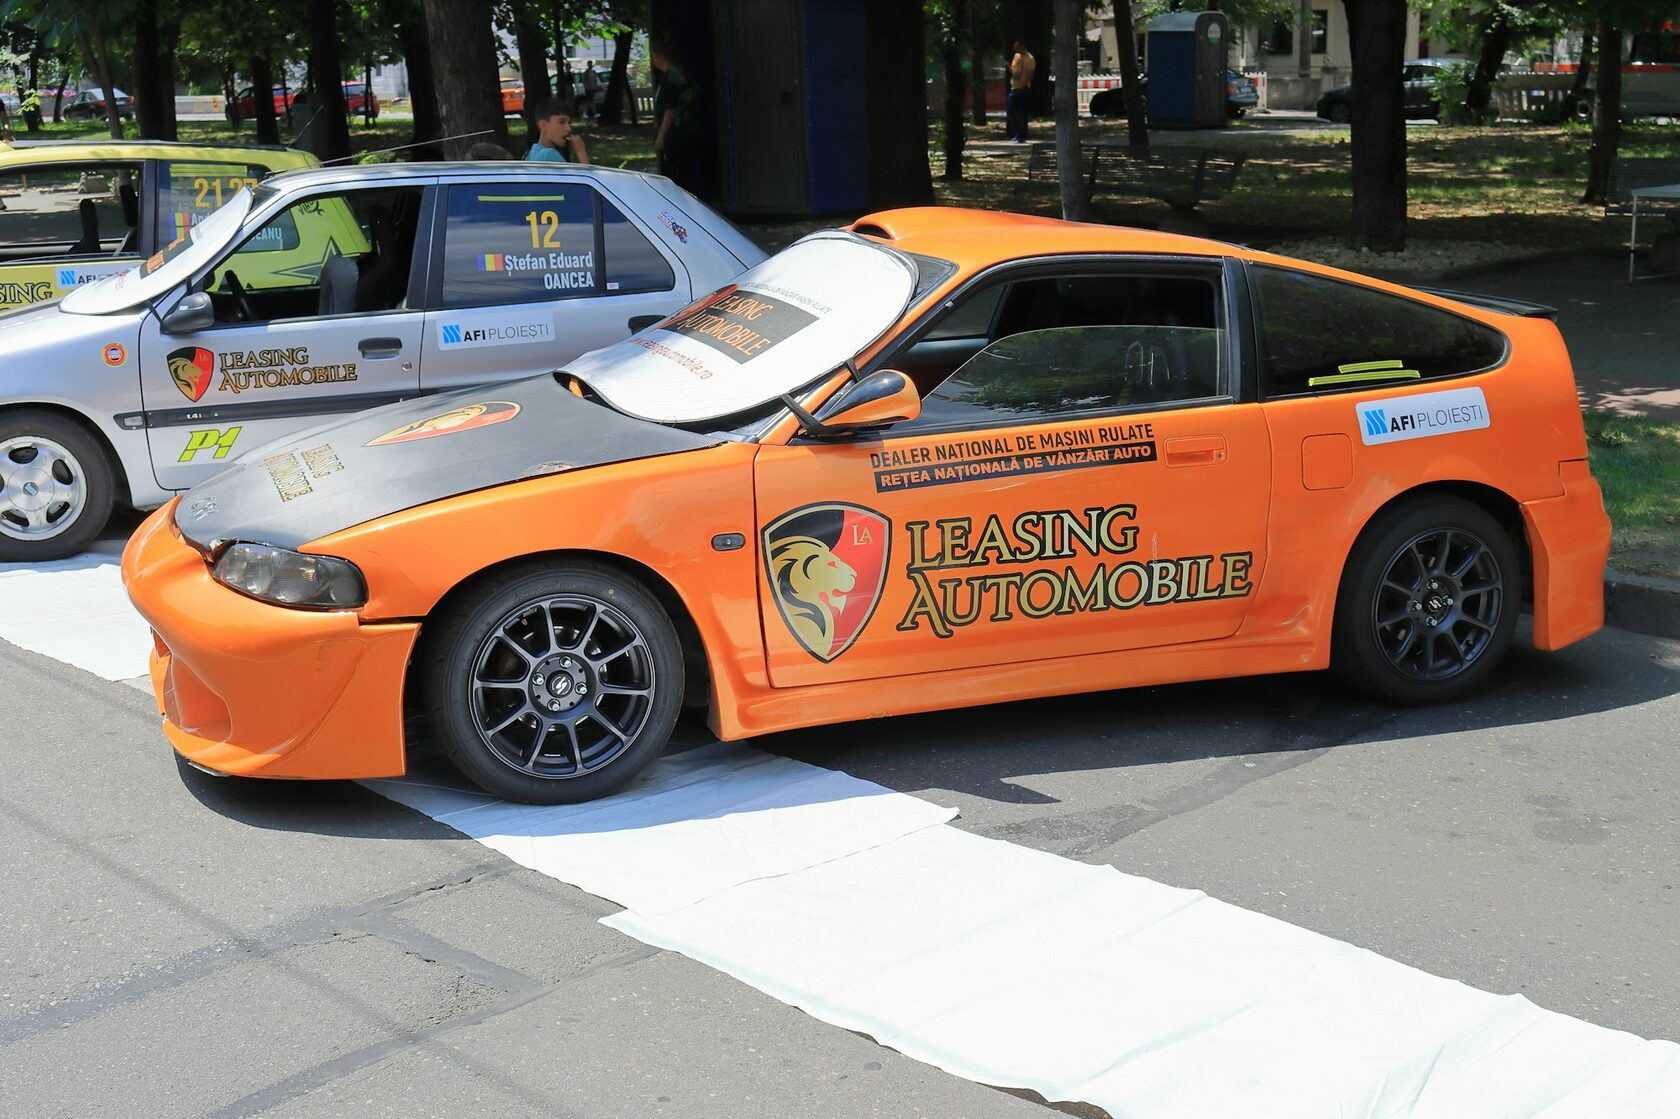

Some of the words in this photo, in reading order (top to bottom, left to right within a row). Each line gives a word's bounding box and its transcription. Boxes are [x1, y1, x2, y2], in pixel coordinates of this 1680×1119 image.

[525, 210, 561, 249] 12
[504, 254, 547, 277] Ștefan
[549, 251, 593, 270] Eduard
[544, 271, 594, 290] OANCEA
[710, 294, 774, 321] LEASING
[463, 329, 486, 342] AFI
[488, 323, 549, 339] PLOIEȘTI
[676, 308, 772, 356] AUTOMOBILE
[218, 347, 309, 370] LEASING
[218, 363, 358, 394] AUTOMOBILE
[1390, 415, 1416, 433] AFI
[1417, 404, 1483, 427] PLOIEȘTI
[870, 446, 931, 468] DEALER
[1016, 435, 1036, 451] DE
[1098, 423, 1155, 443] RULATE
[880, 468, 932, 488] REȚEA
[1024, 456, 1043, 469] DE
[1045, 448, 1110, 466] VÂNZĂRI
[1113, 445, 1152, 460] AUTO
[851, 524, 875, 547] LA
[905, 504, 1140, 571] LEASING
[895, 550, 1252, 638] AUTOMOBILE
